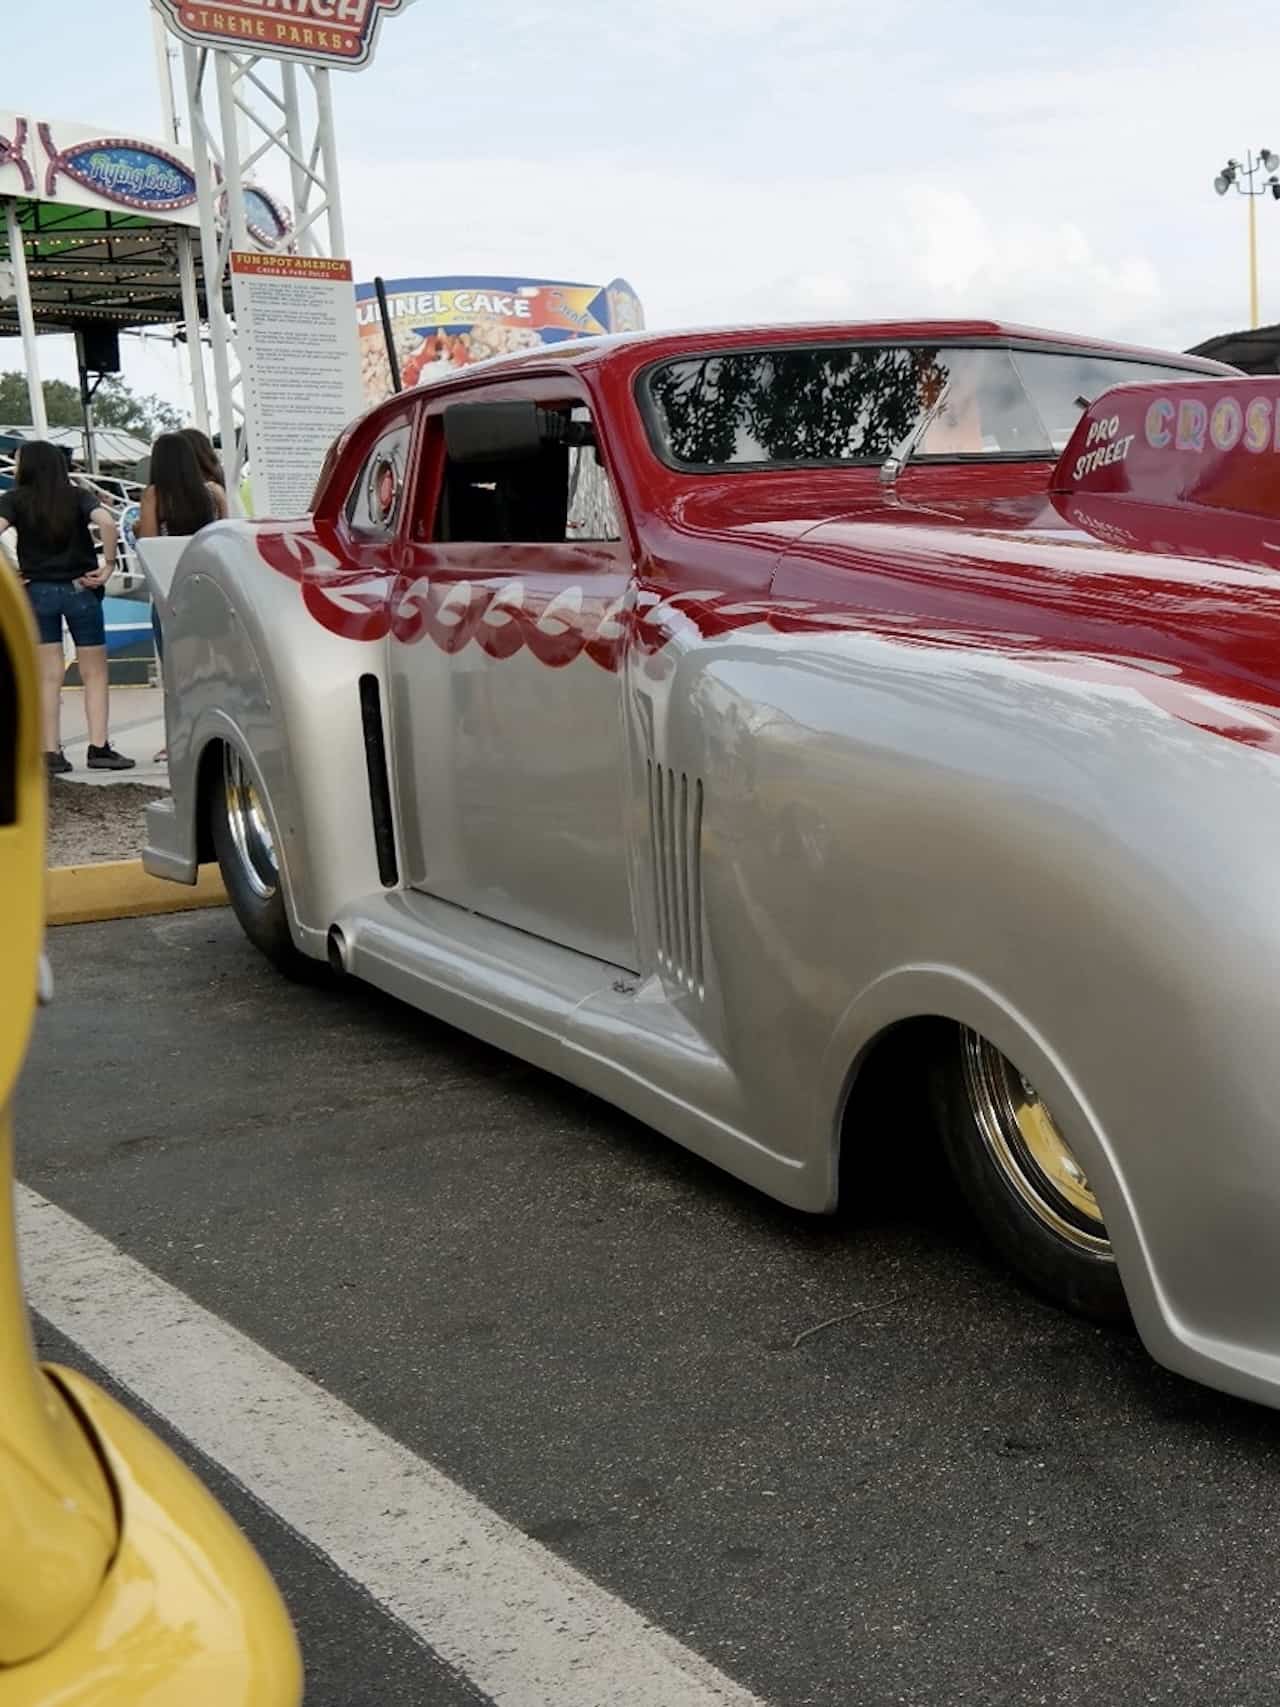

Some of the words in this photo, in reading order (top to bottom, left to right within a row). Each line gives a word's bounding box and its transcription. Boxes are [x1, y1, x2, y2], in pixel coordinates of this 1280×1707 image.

[199, 11, 265, 36] THEME
[276, 24, 343, 49] PARKS
[236, 254, 262, 265] FUN
[263, 256, 294, 268] SPOT
[294, 259, 347, 271] AMERICA
[356, 294, 447, 325] UNNEL
[454, 290, 531, 318] CAKE
[1085, 415, 1119, 447] PRO
[1072, 435, 1135, 481] STREET
